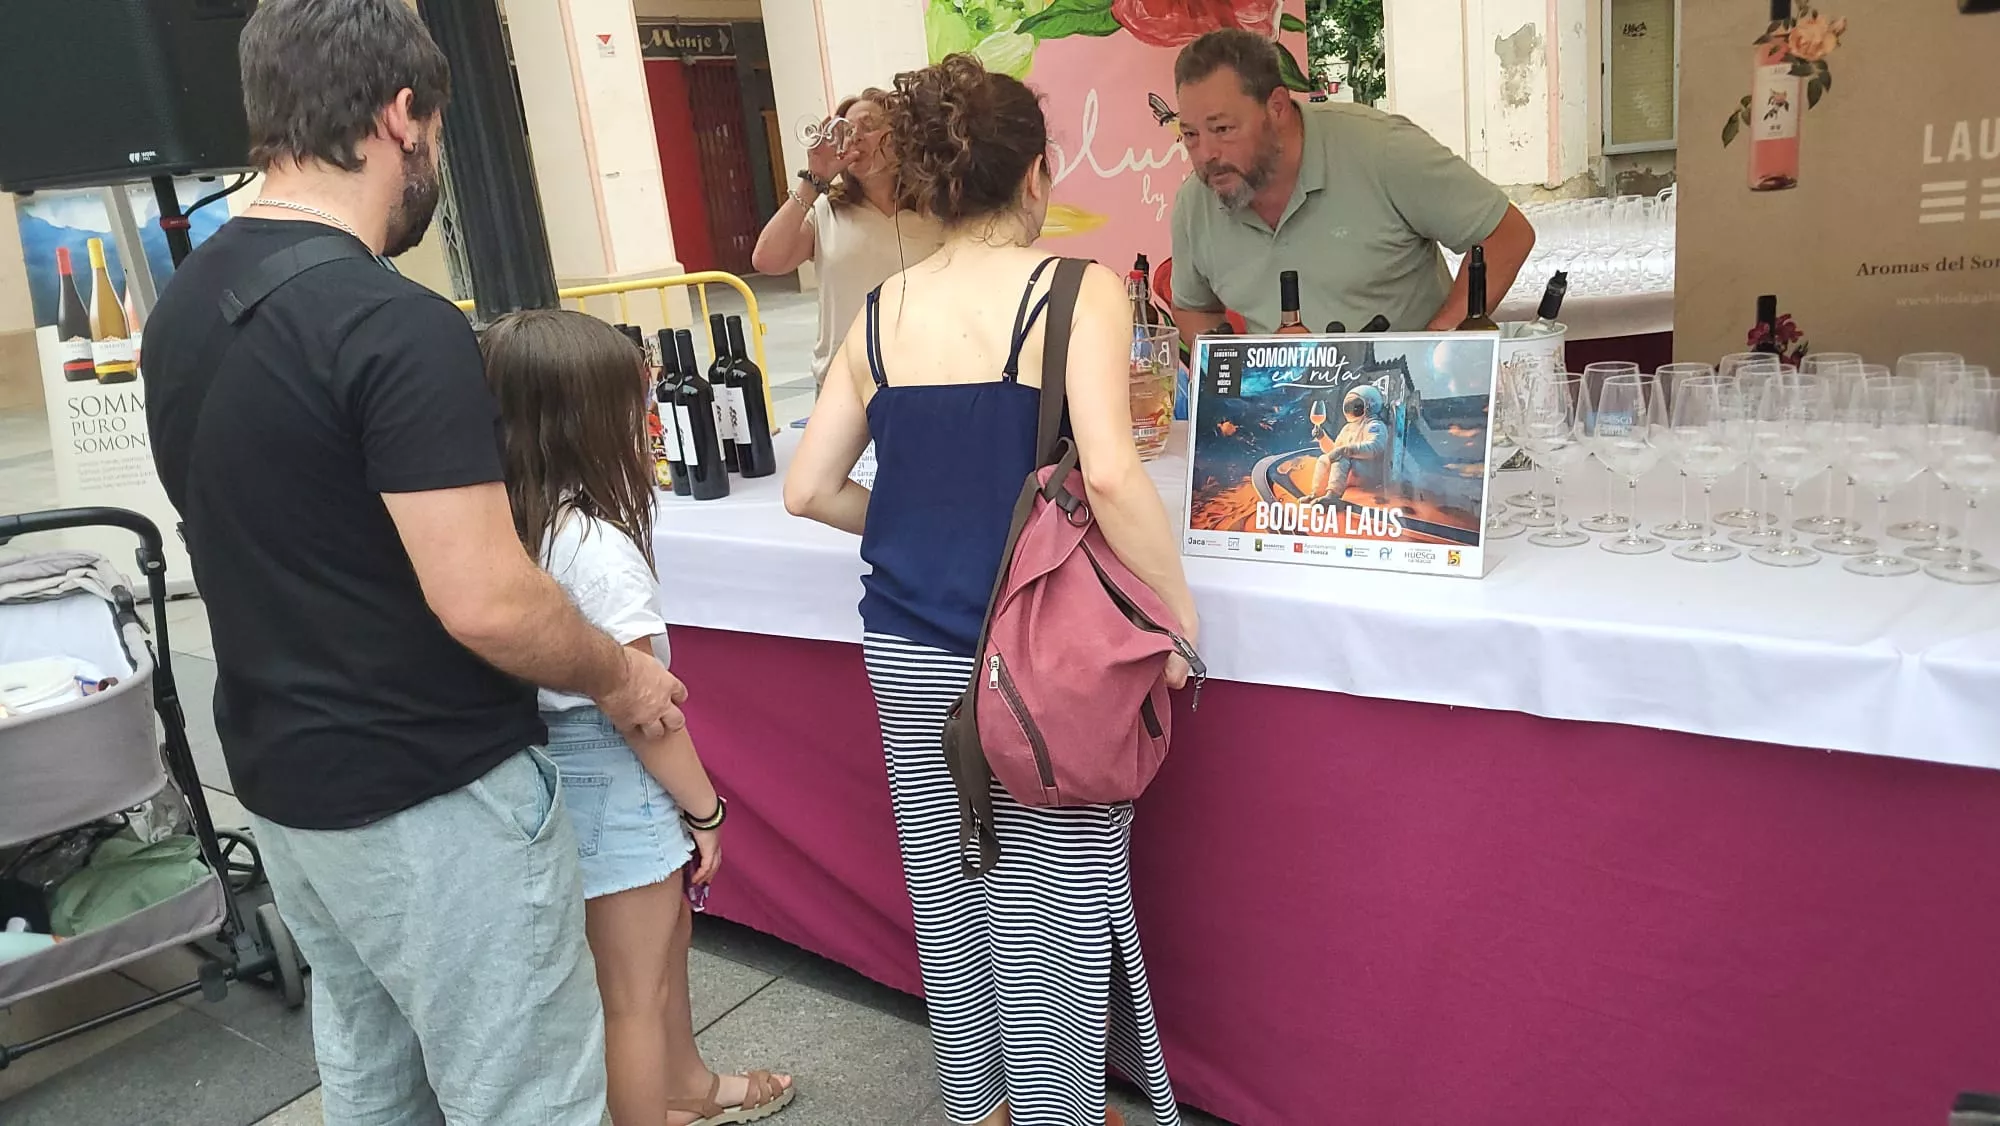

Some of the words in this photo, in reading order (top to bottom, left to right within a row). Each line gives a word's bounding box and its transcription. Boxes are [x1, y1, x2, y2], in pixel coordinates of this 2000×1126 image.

[1856, 261, 1929, 276] Aromas
[1936, 255, 1964, 271] del
[1246, 346, 1337, 368] SOMONTANO
[1271, 368, 1302, 382] en
[1309, 355, 1361, 386] ruta
[72, 417, 126, 436] PURO
[1255, 501, 1339, 534] BODEGA
[1345, 505, 1403, 538] LAUS
